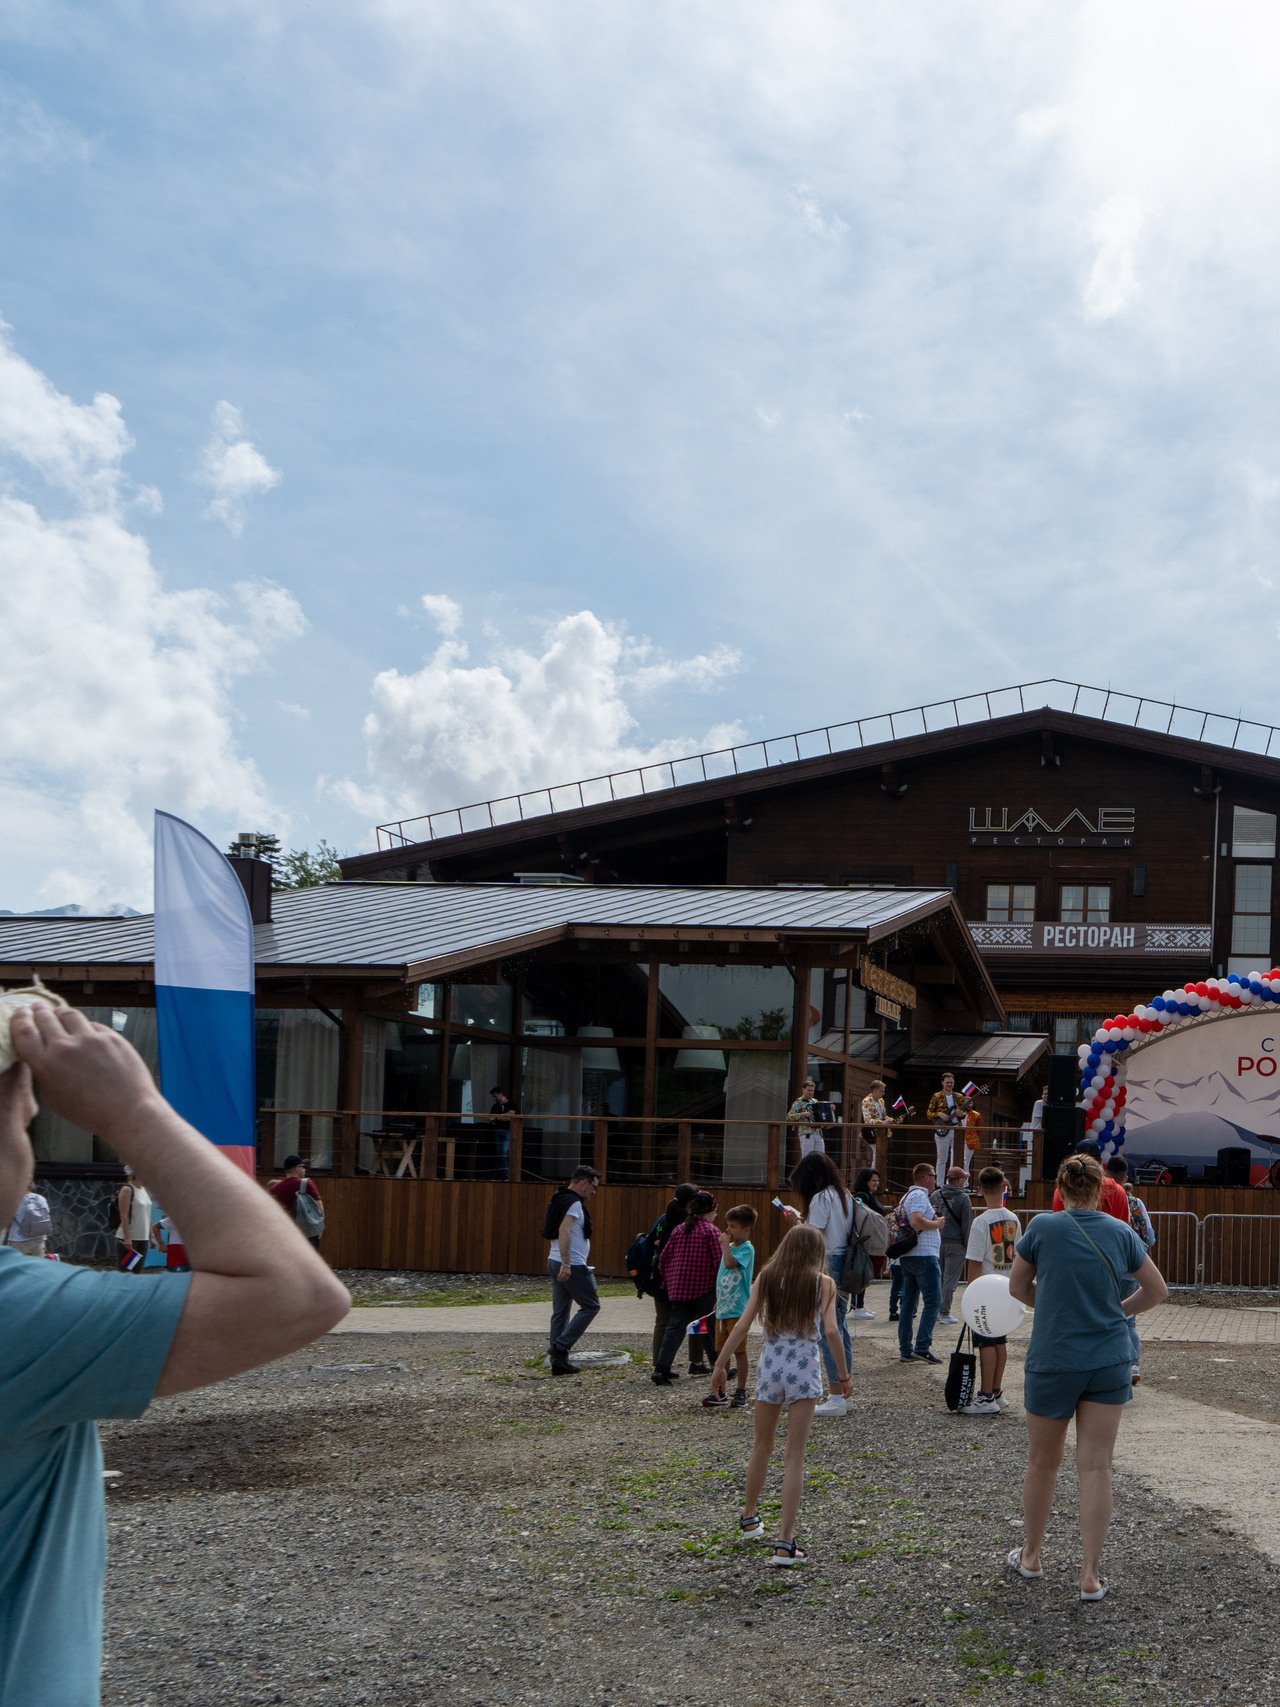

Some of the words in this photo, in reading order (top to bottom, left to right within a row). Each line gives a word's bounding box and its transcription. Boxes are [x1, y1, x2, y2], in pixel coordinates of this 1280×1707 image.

[971, 837, 1130, 846] РЕСТОРАН
[1043, 926, 1135, 948] РЕСТОРАН
[1261, 1037, 1275, 1053] С
